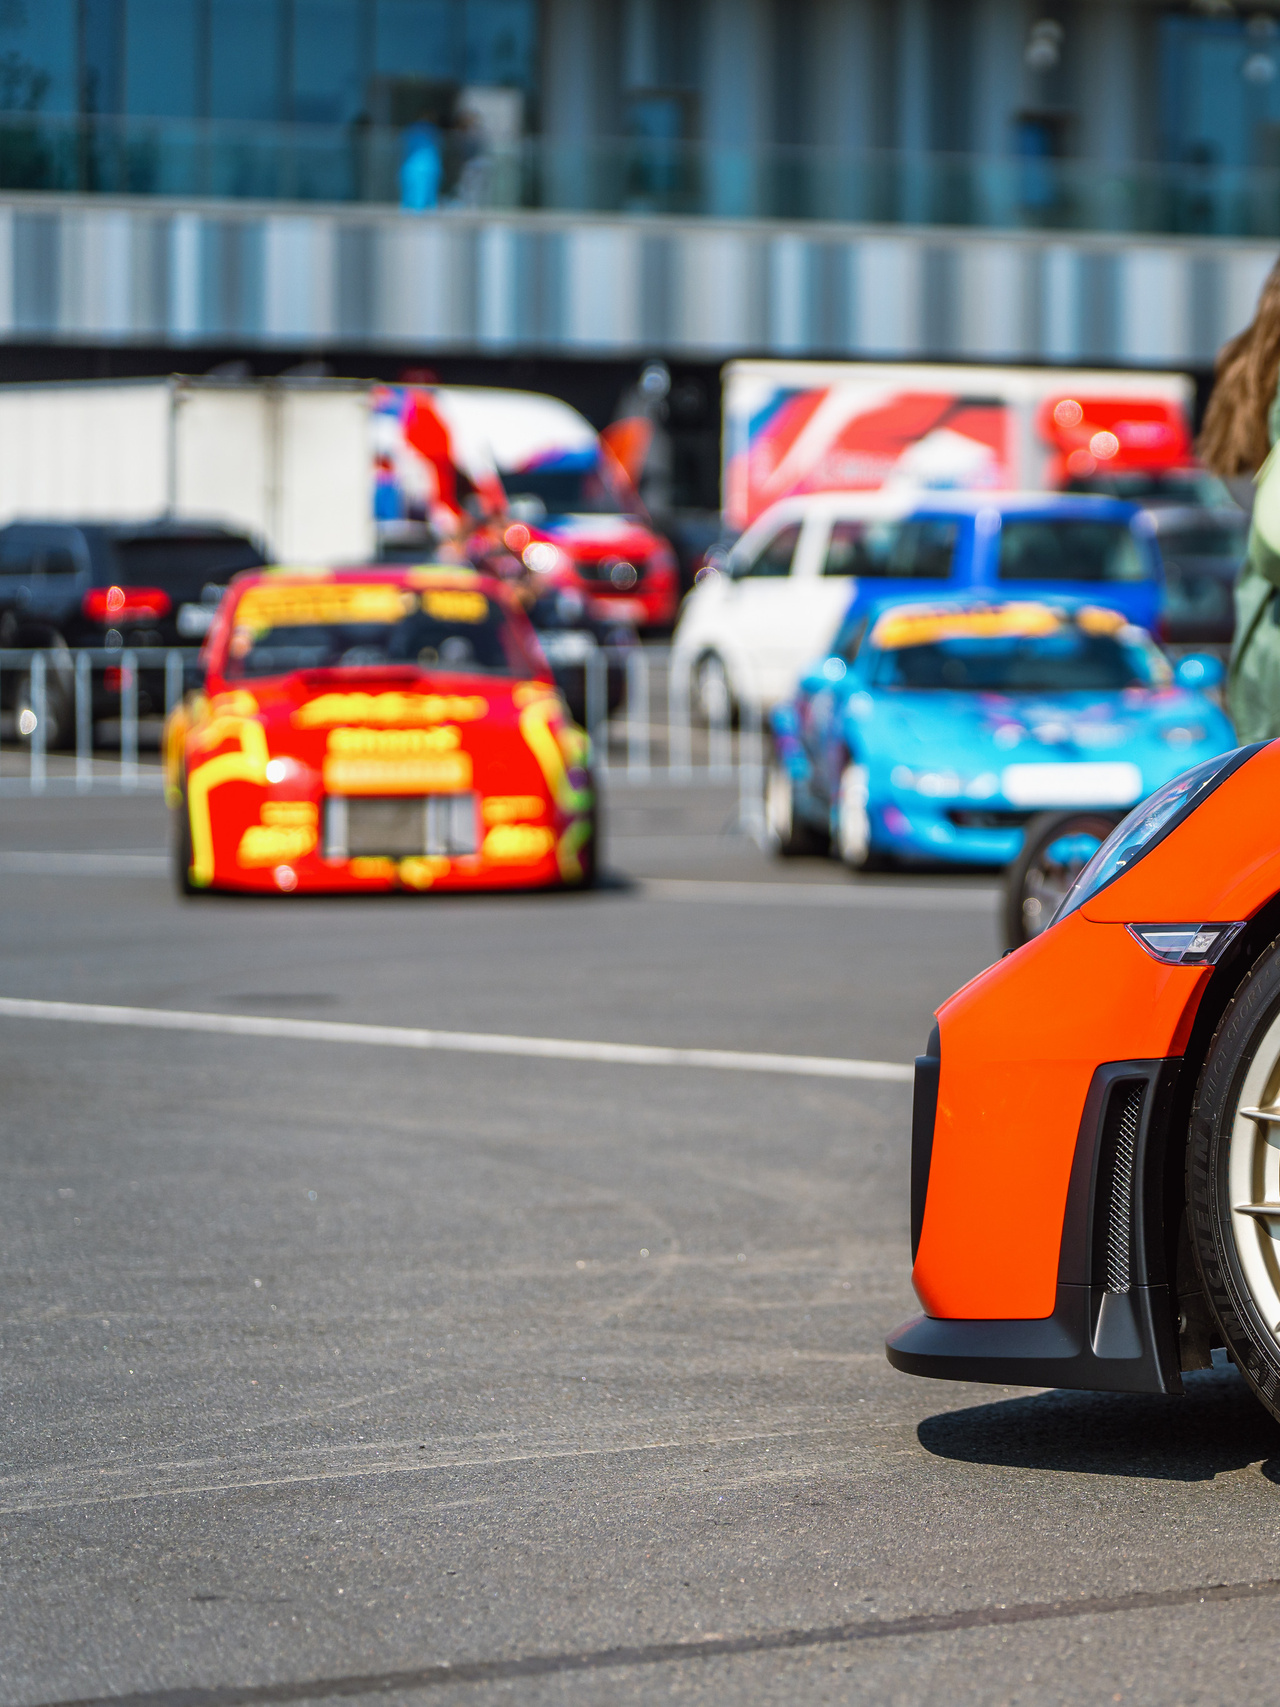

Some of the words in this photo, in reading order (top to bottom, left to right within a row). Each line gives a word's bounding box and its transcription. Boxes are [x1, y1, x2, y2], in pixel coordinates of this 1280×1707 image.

[1204, 1049, 1228, 1107] PILOT
[1226, 981, 1263, 1043] SPORT
[1192, 1131, 1246, 1341] MICHELIN
